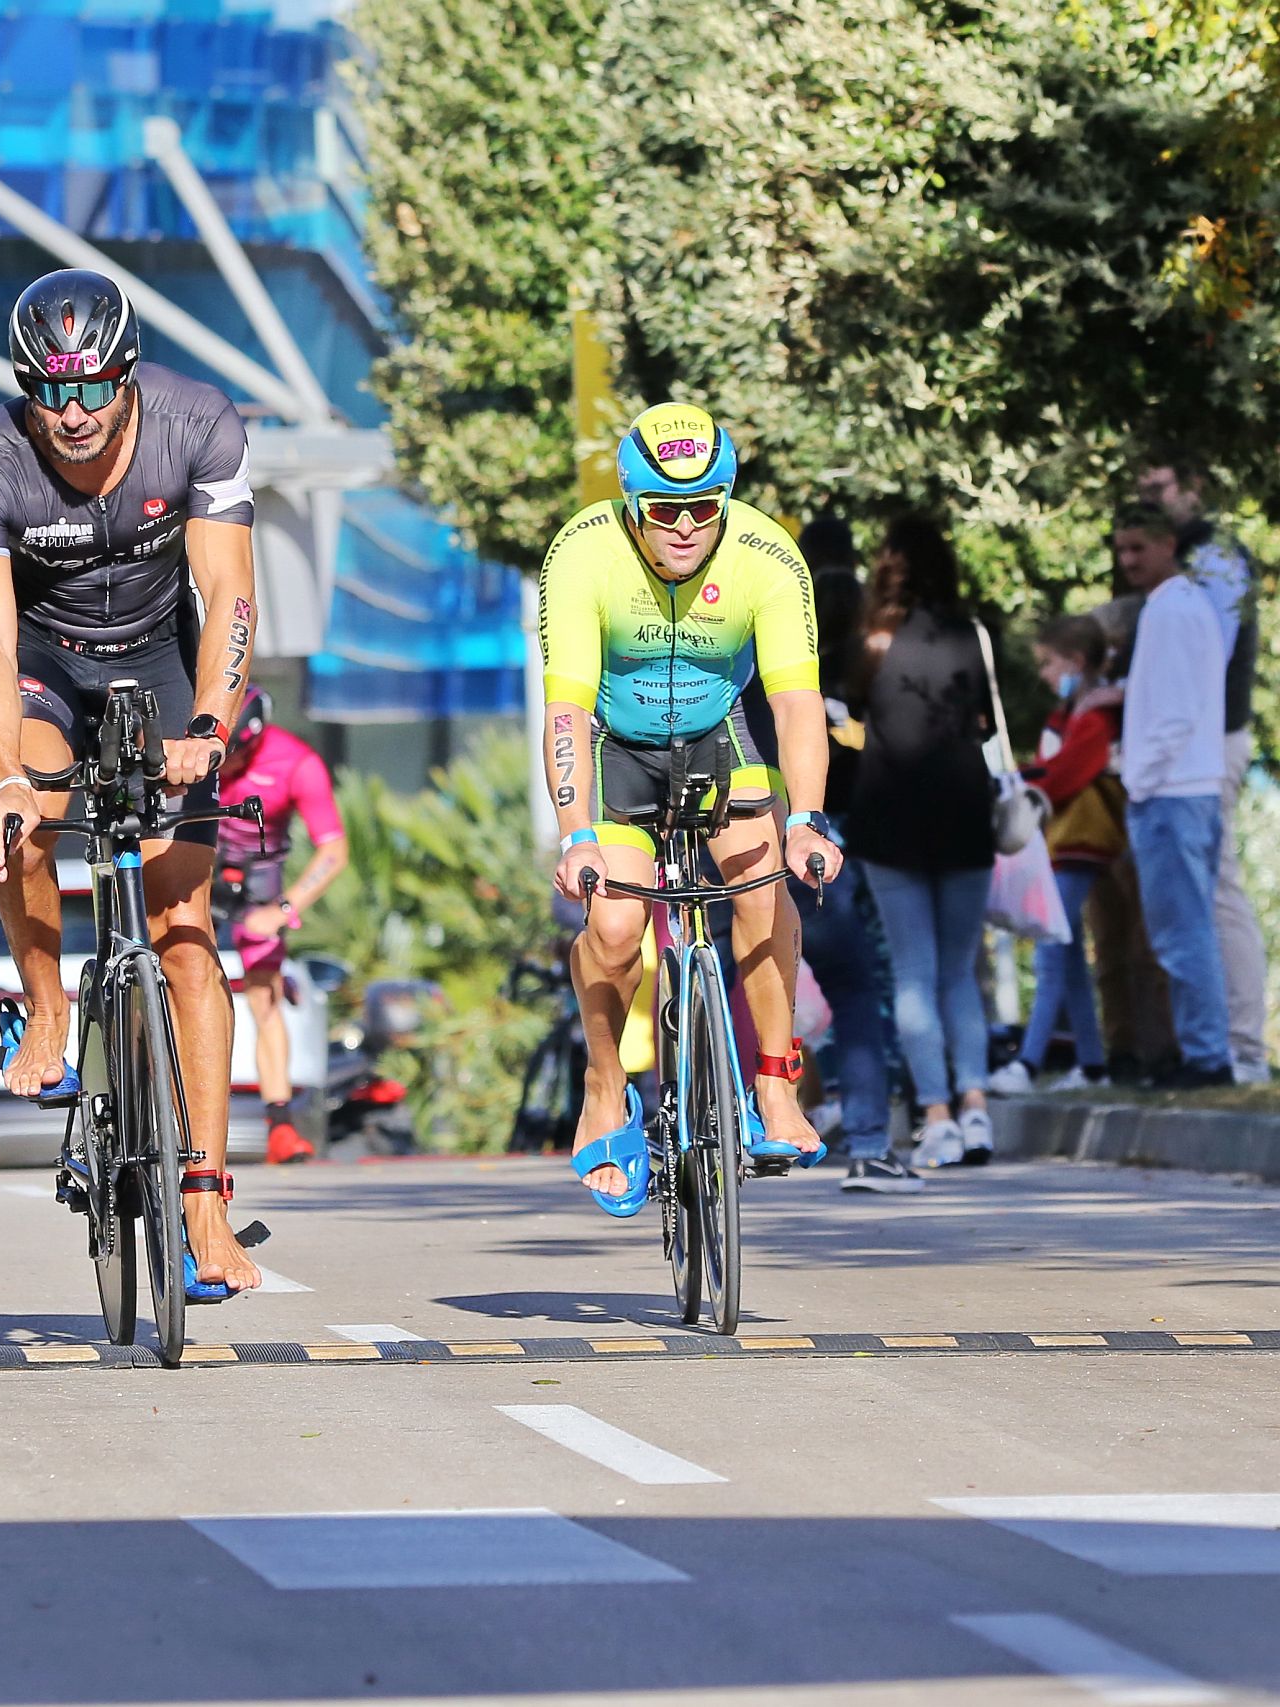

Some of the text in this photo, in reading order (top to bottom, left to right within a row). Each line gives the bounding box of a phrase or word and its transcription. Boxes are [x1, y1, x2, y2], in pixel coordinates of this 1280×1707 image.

[46, 353, 82, 373] 377
[658, 440, 695, 460] 279
[24, 522, 94, 539] IRONMAN
[48, 536, 76, 549] PULA
[224, 622, 249, 692] 377
[642, 679, 709, 689] INTERSPORT
[555, 736, 575, 807] 279
